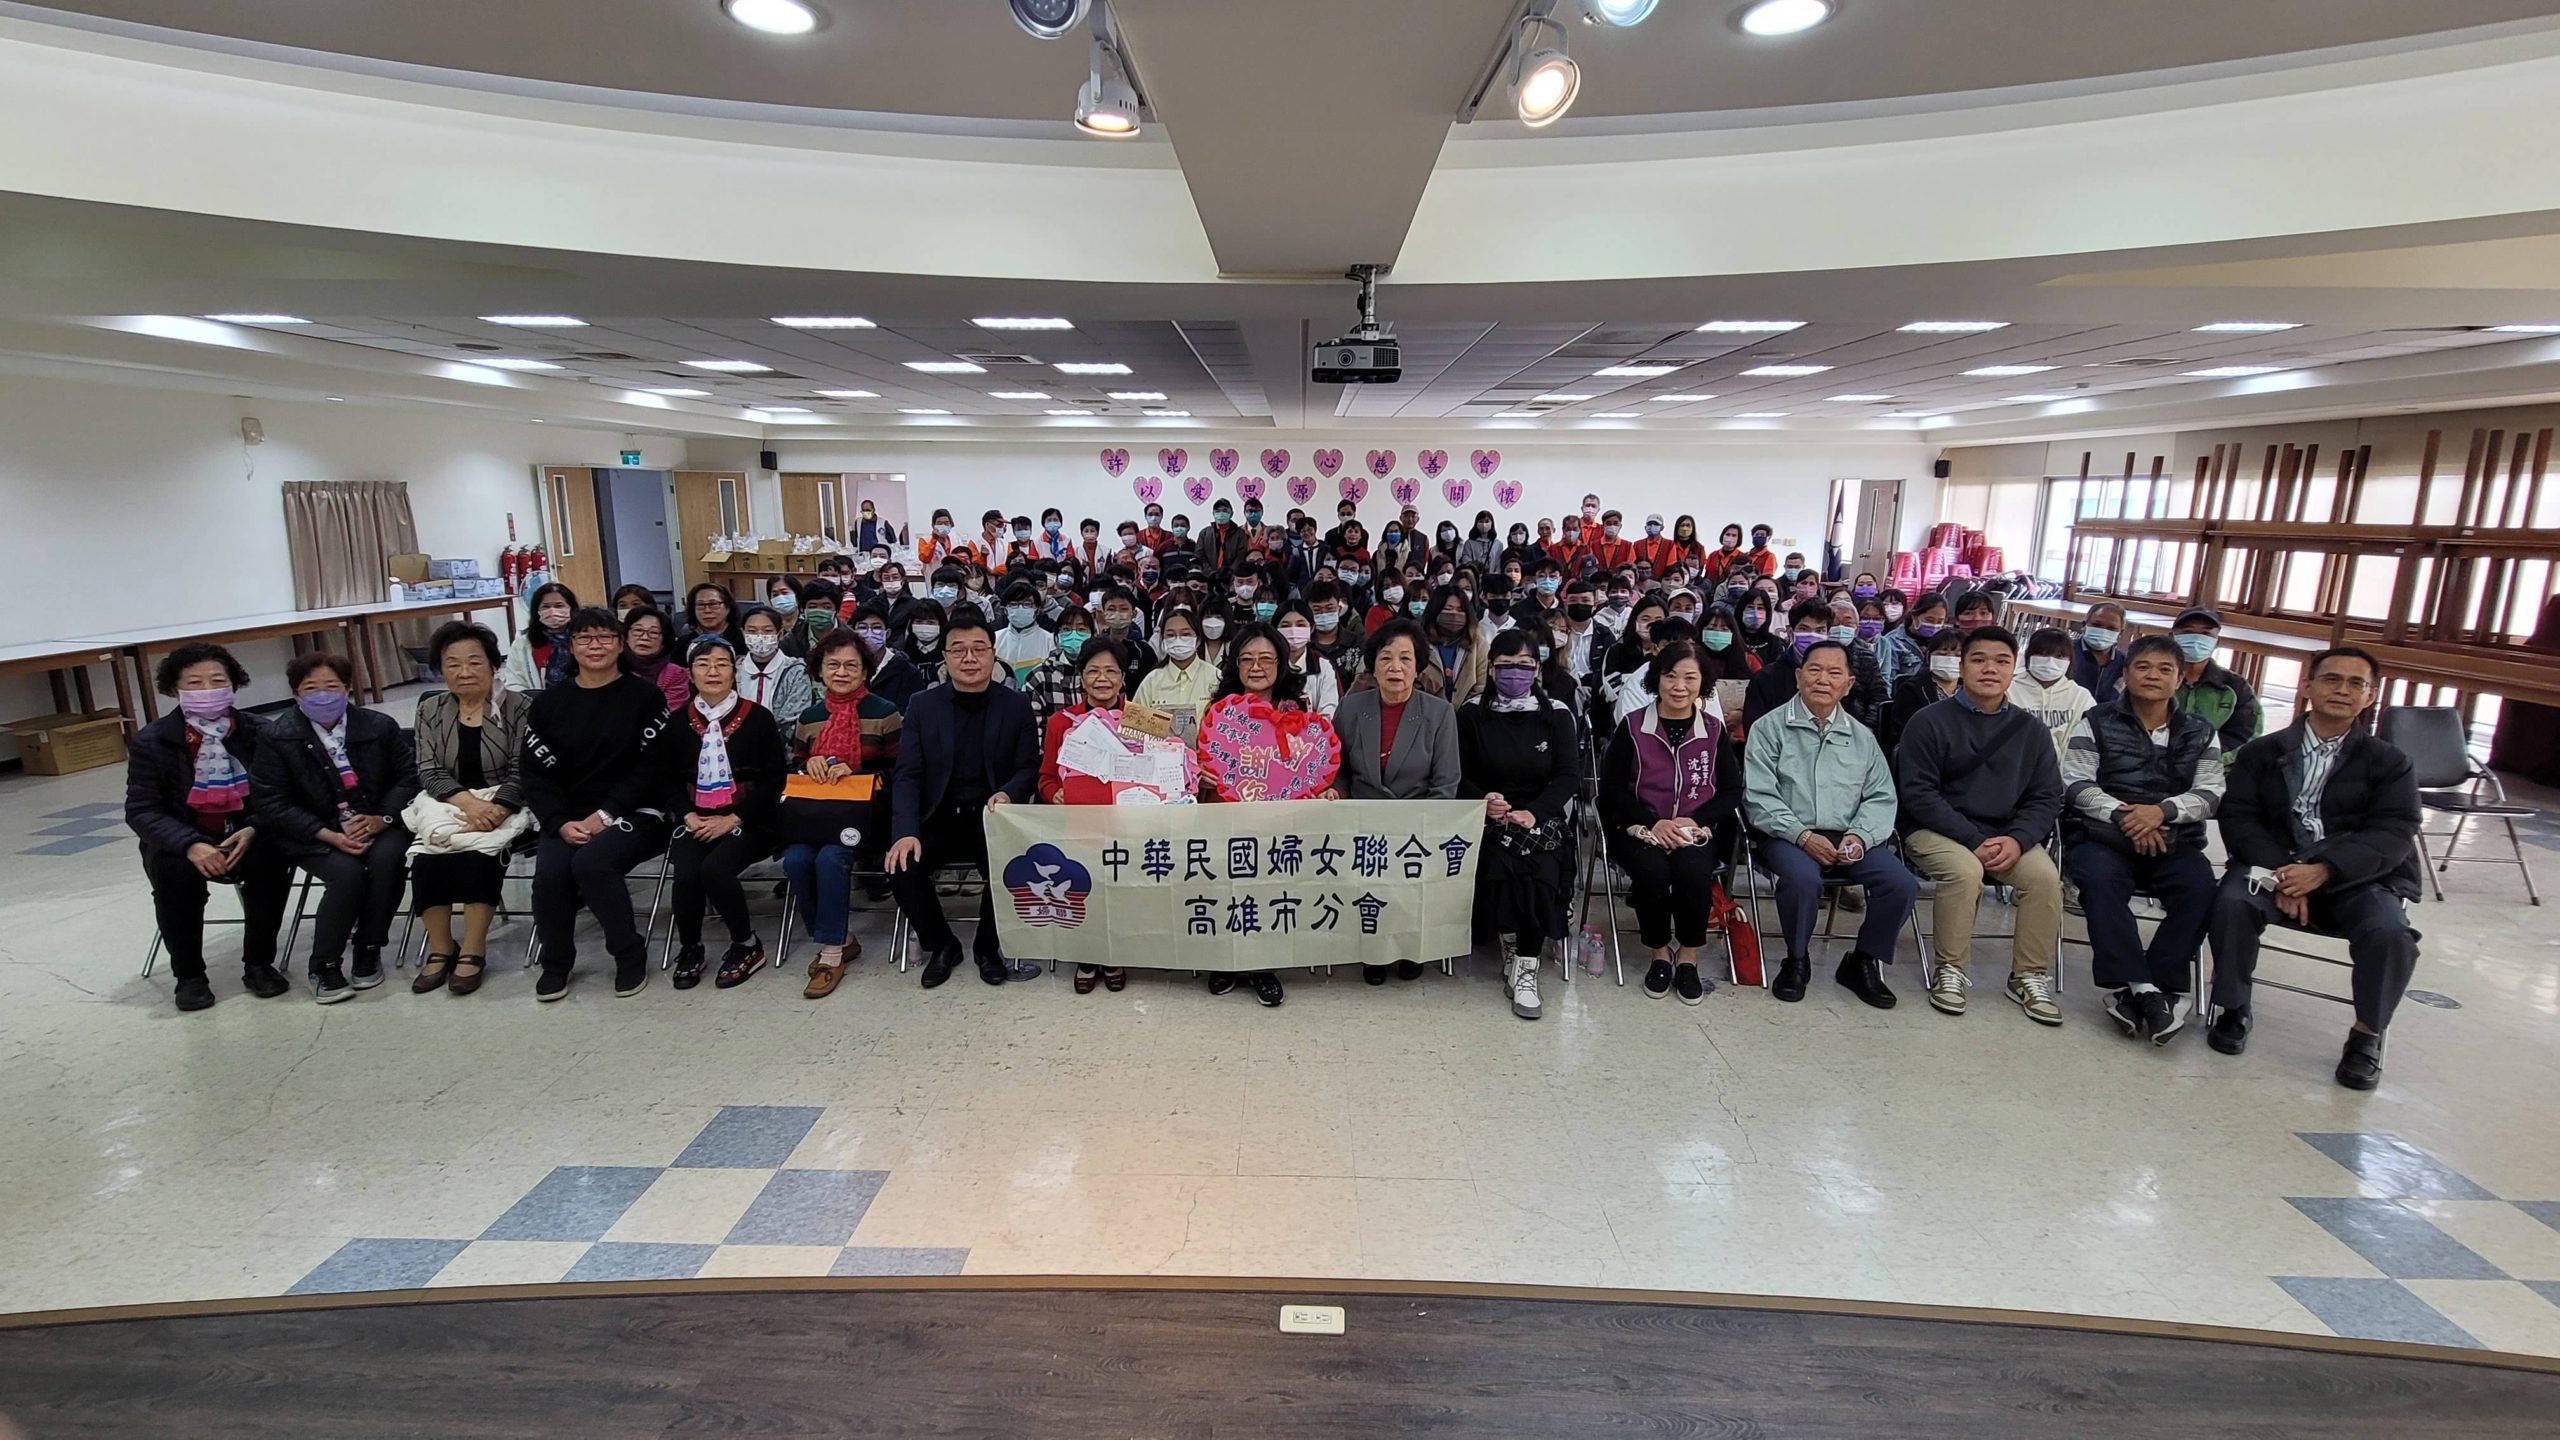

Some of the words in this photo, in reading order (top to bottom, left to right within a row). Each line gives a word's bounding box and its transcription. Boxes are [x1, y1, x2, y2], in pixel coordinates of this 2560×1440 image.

[1106, 455, 1493, 476] 許崑源愛心慈善會
[1138, 483, 1517, 503] 以愛思源永續關懷
[1101, 833, 1474, 883] 中華民國婦女聯合會
[1183, 890, 1389, 937] 高雄市分會
